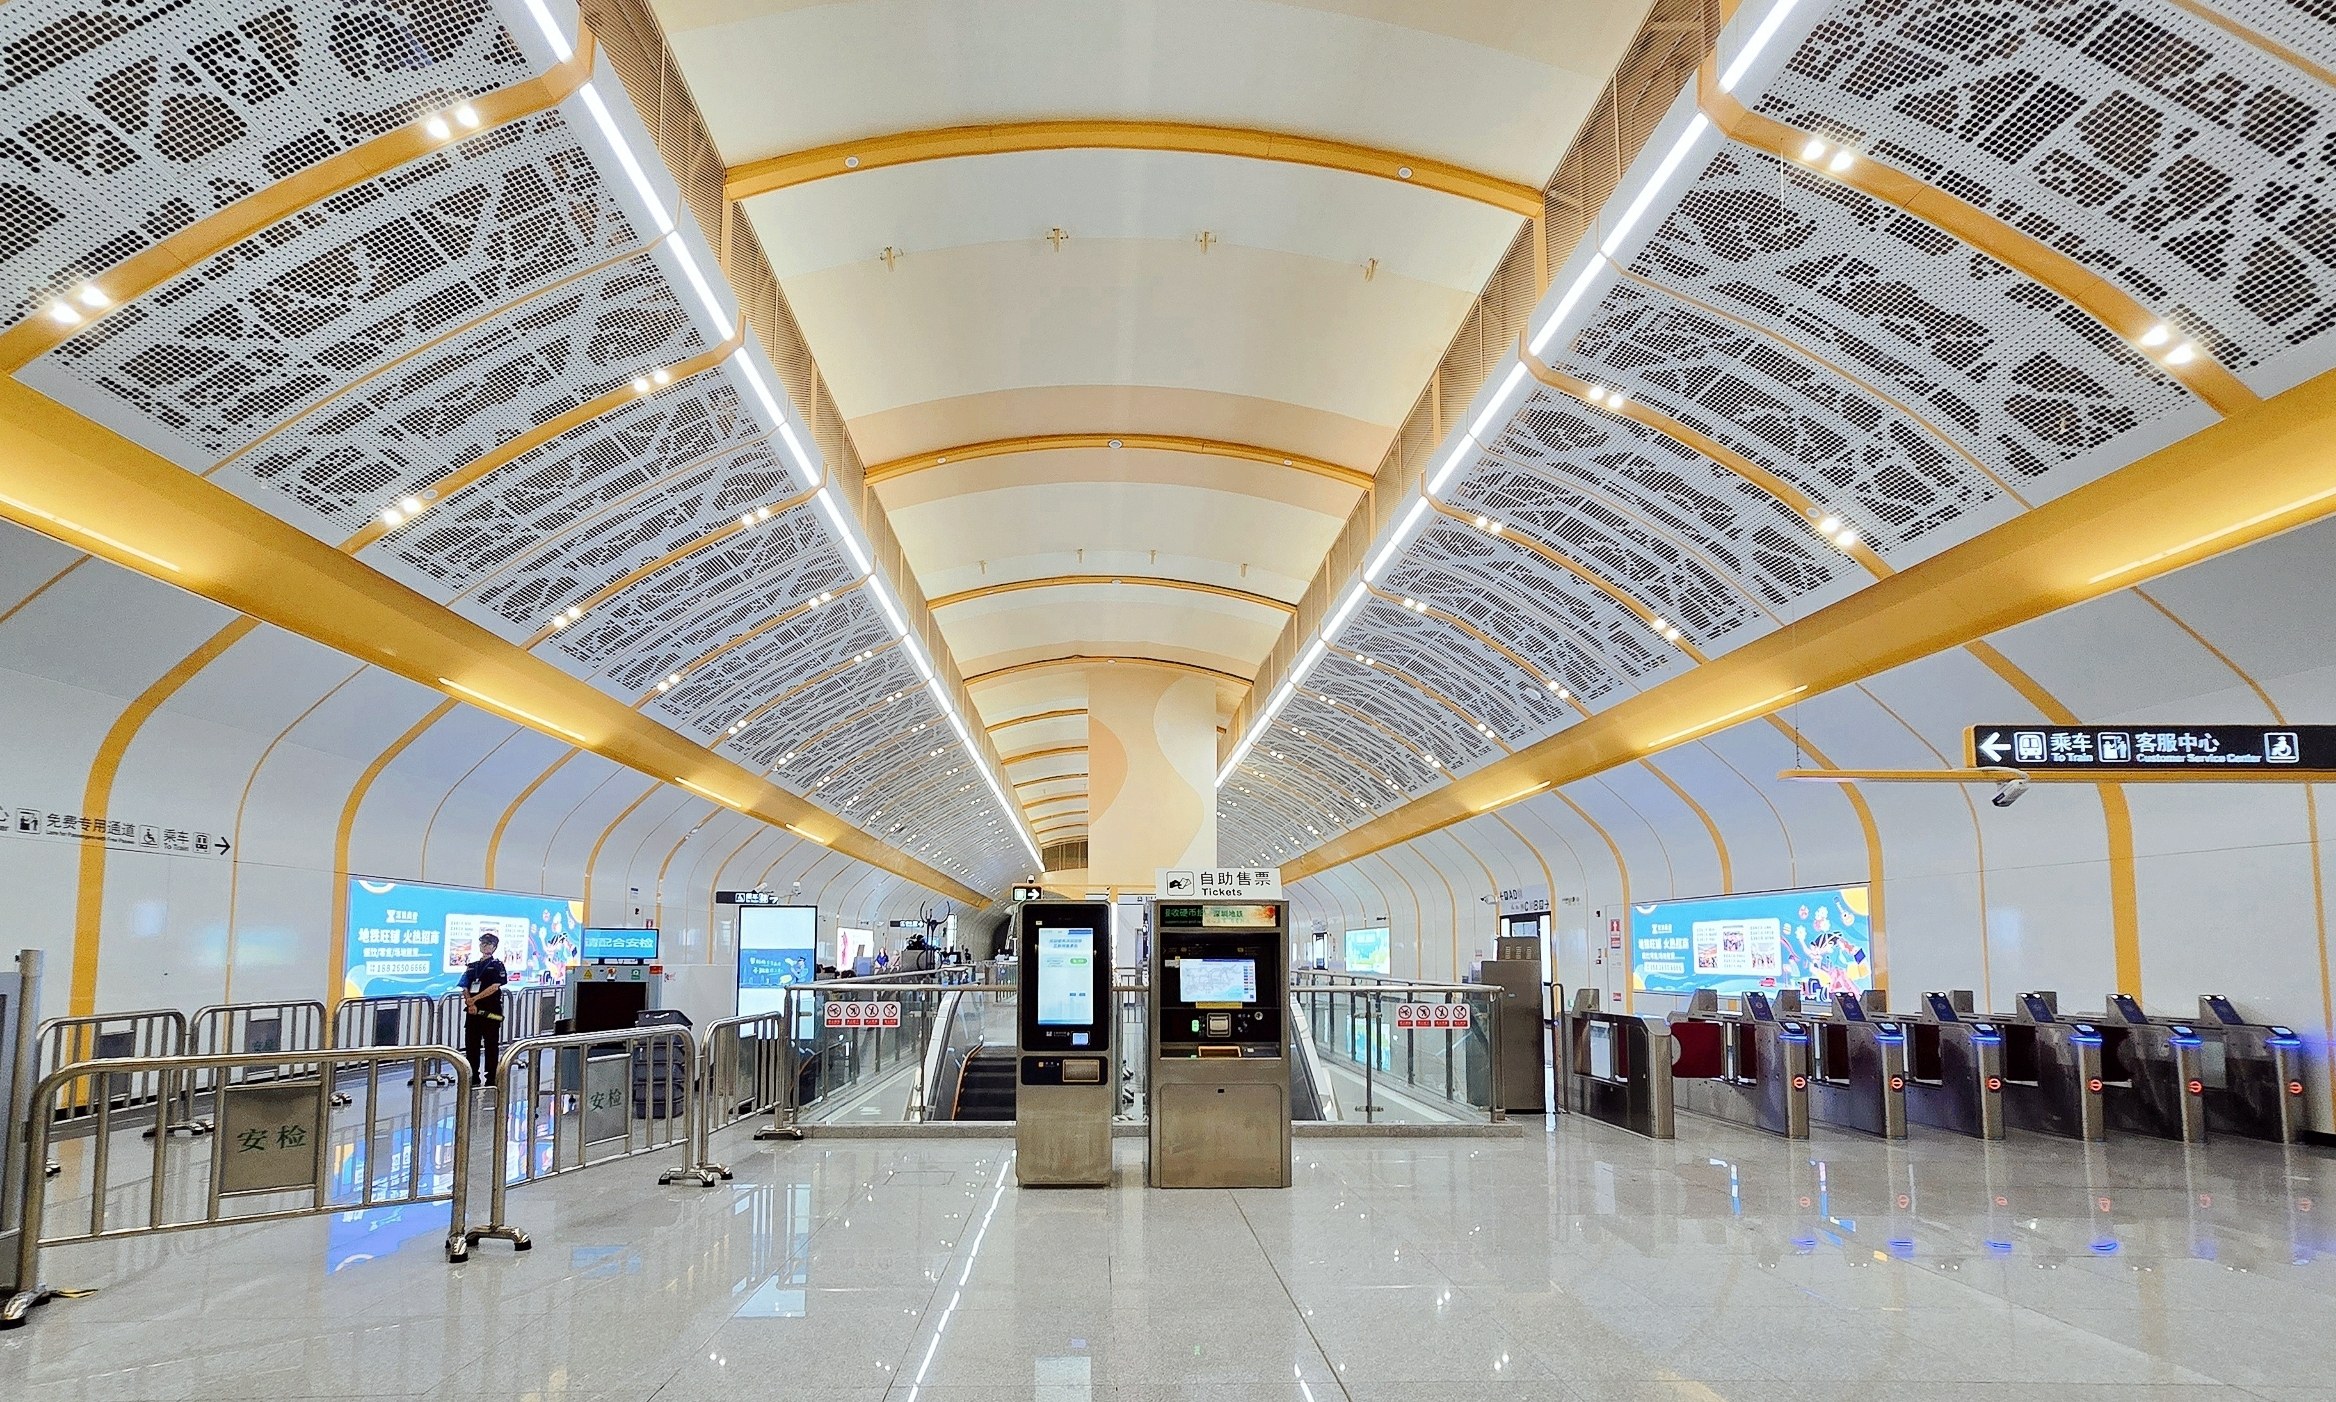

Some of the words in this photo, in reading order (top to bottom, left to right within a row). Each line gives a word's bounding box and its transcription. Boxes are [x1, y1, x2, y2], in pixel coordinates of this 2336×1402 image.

[2050, 732, 2093, 752] 乘车
[2135, 732, 2220, 753] 客服中心
[2051, 753, 2066, 762] To
[2066, 753, 2093, 762] Train
[2136, 754, 2186, 763] Customer
[2187, 754, 2225, 763] Service
[2227, 754, 2262, 763] Center
[47, 813, 136, 838] 免费专用通道
[163, 829, 190, 844] 乘车
[164, 842, 172, 850] To
[173, 843, 190, 851] Train
[1200, 871, 1271, 887] 自助售票
[1202, 887, 1243, 896] Tickets
[584, 937, 654, 948] 请配合安检
[589, 1088, 622, 1112] 安检
[236, 1124, 308, 1153] 安检
